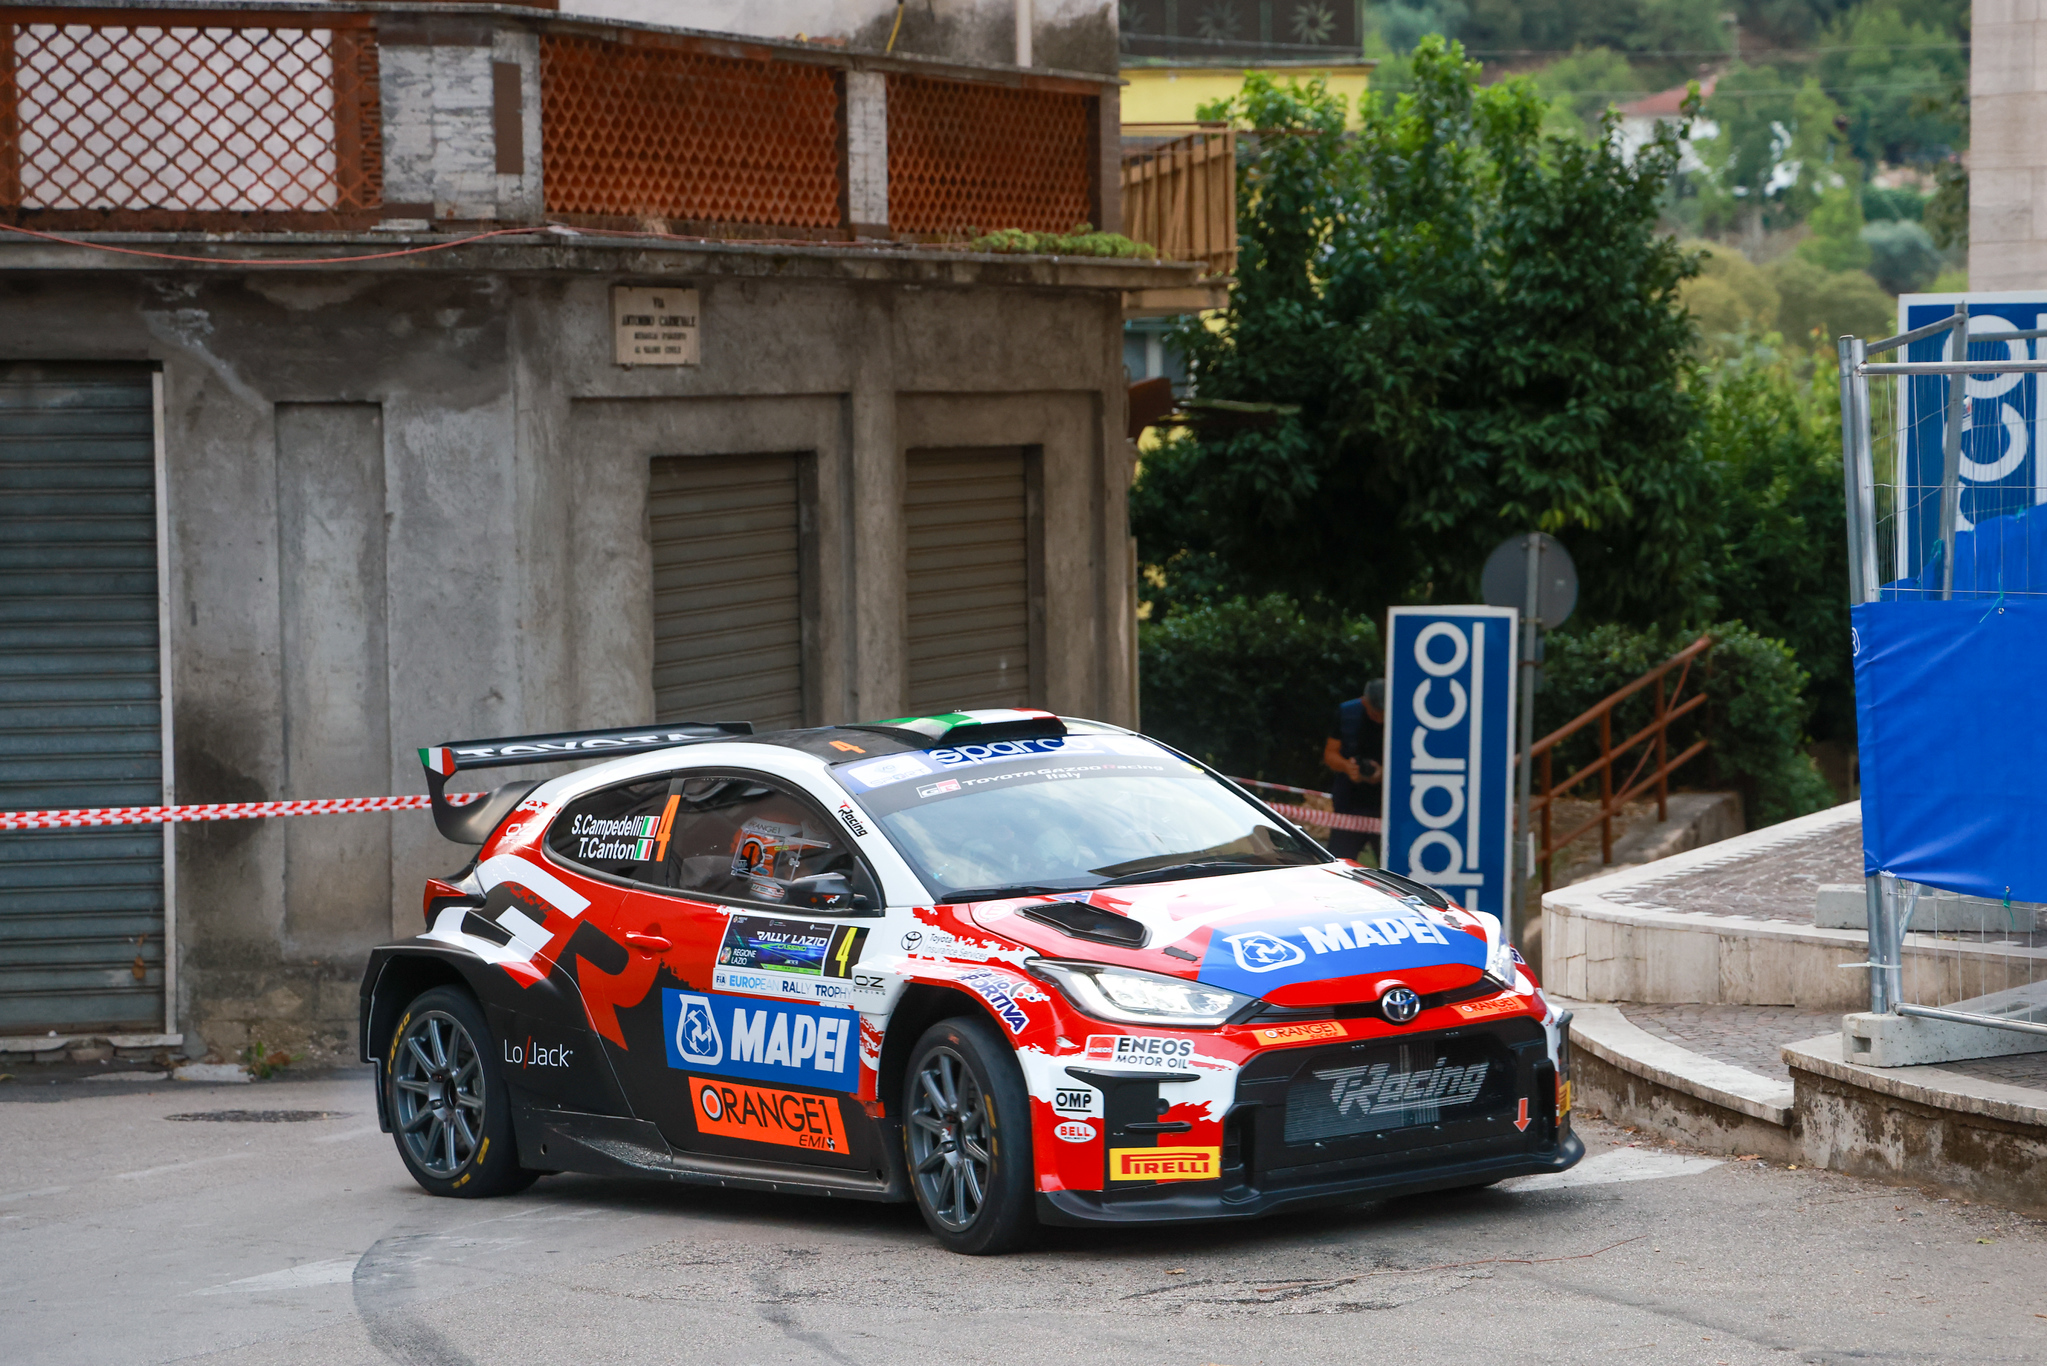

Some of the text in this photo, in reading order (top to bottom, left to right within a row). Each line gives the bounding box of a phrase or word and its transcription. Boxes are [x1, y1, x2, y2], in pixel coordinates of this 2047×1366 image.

[829, 740, 867, 754] 4
[961, 770, 1037, 785] TOYOTA
[1038, 764, 1102, 775] GAZOO
[1046, 771, 1081, 780] Italy
[571, 813, 643, 841] S.Campedelli
[655, 795, 681, 862] 4
[578, 837, 636, 860] T.Canton
[757, 931, 828, 947] RALLY LAZIO
[929, 933, 953, 944] Toyota
[1298, 916, 1449, 955] MAPEI
[732, 948, 757, 958] REGIONE
[835, 927, 858, 977] 4
[924, 944, 988, 961] Insurance Services
[730, 957, 748, 966] LAZIO
[729, 975, 781, 992] EUROPEAN
[782, 980, 812, 995] RALLY
[815, 984, 853, 1000] TROPHY
[730, 1007, 850, 1073] MAPEI
[1117, 1037, 1191, 1056] ENEOS
[1115, 1055, 1188, 1068] MOTOR OIL
[1056, 1092, 1092, 1108] OMP
[700, 1084, 833, 1135] ORANGE1
[1060, 1125, 1090, 1137] BELL
[799, 1134, 825, 1149] EMI
[1121, 1153, 1210, 1175] PIRELLI
